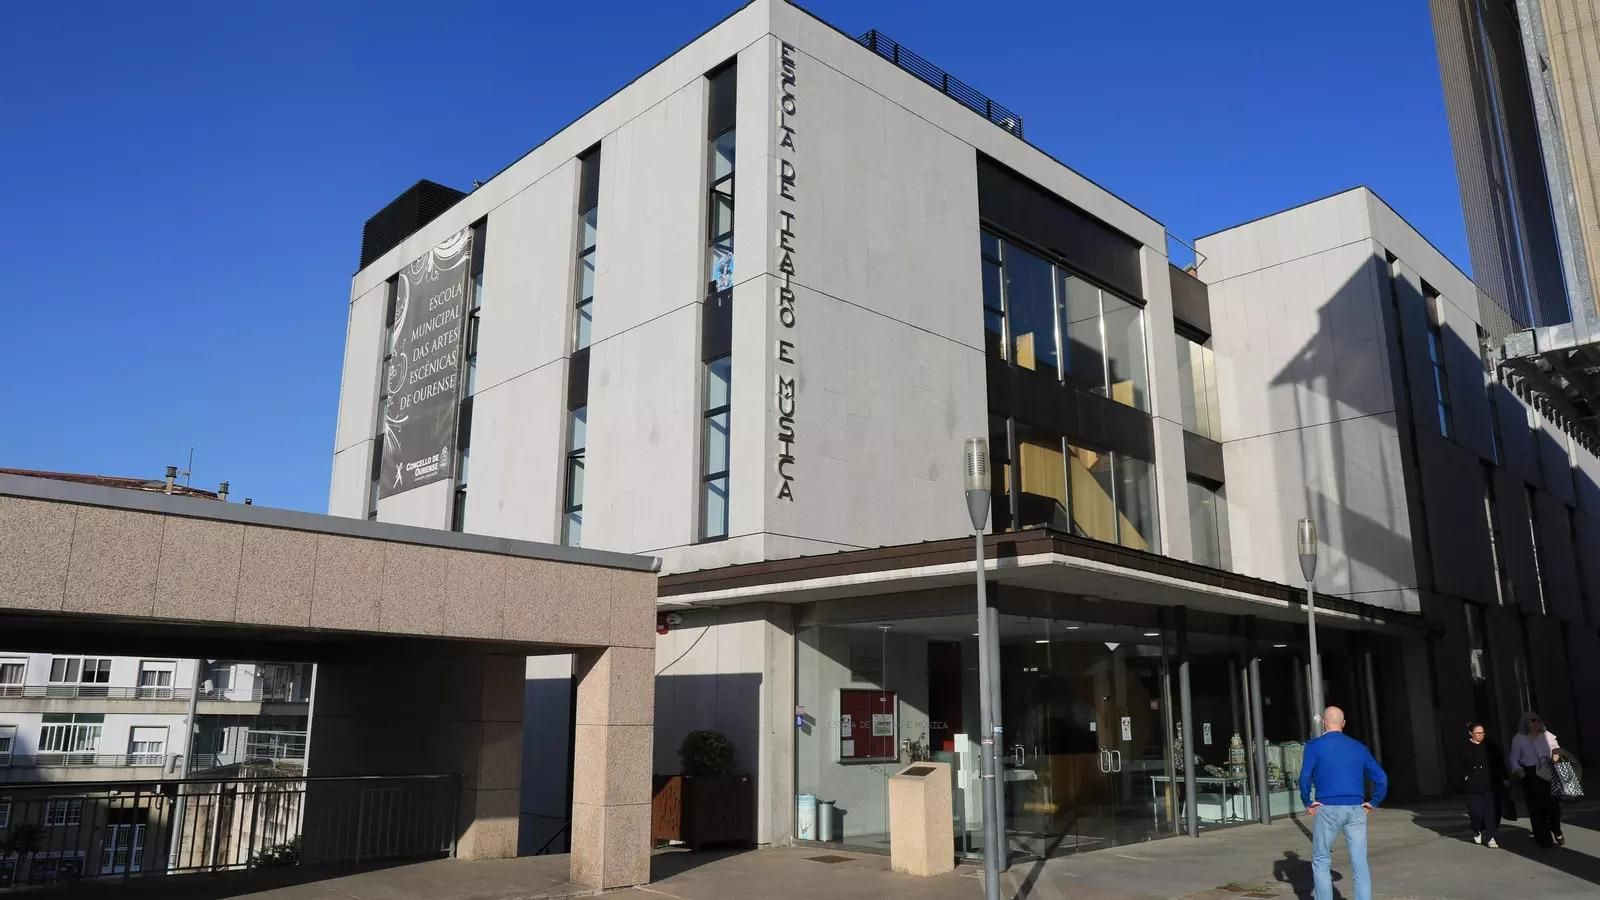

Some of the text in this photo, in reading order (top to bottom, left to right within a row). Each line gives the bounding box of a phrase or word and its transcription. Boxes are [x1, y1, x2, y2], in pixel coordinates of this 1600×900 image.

[780, 40, 796, 152] ESCOLA
[780, 158, 796, 202] DE
[779, 210, 796, 328] TEATRO
[429, 282, 462, 311] ESCOLA
[411, 304, 460, 342] MUNICIPAL
[413, 327, 458, 361] DAS ARTES
[779, 339, 795, 364] E
[409, 350, 456, 384] ESCÉNICAS
[400, 374, 456, 410] DE OURENSE
[860, 720, 871, 729] DE
